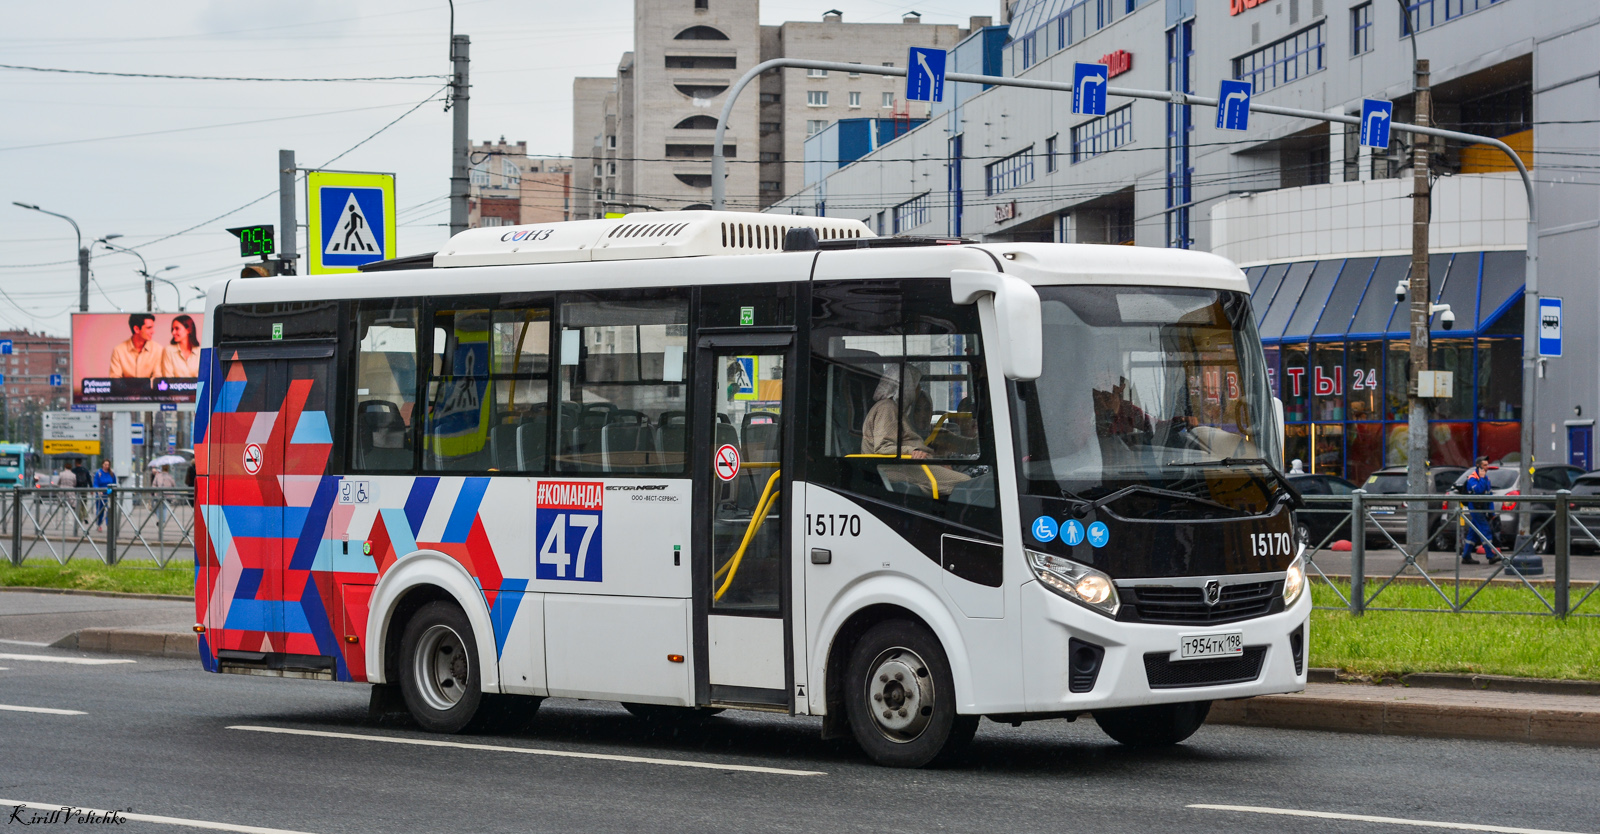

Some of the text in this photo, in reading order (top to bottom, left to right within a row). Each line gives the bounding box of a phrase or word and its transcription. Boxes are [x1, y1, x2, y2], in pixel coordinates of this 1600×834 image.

[1353, 369, 1377, 390] 24
[537, 484, 602, 508] #КОМАНДА
[806, 513, 861, 537] 15170
[540, 513, 599, 578] 47
[1250, 532, 1290, 557] 15170
[1226, 635, 1241, 648] 198
